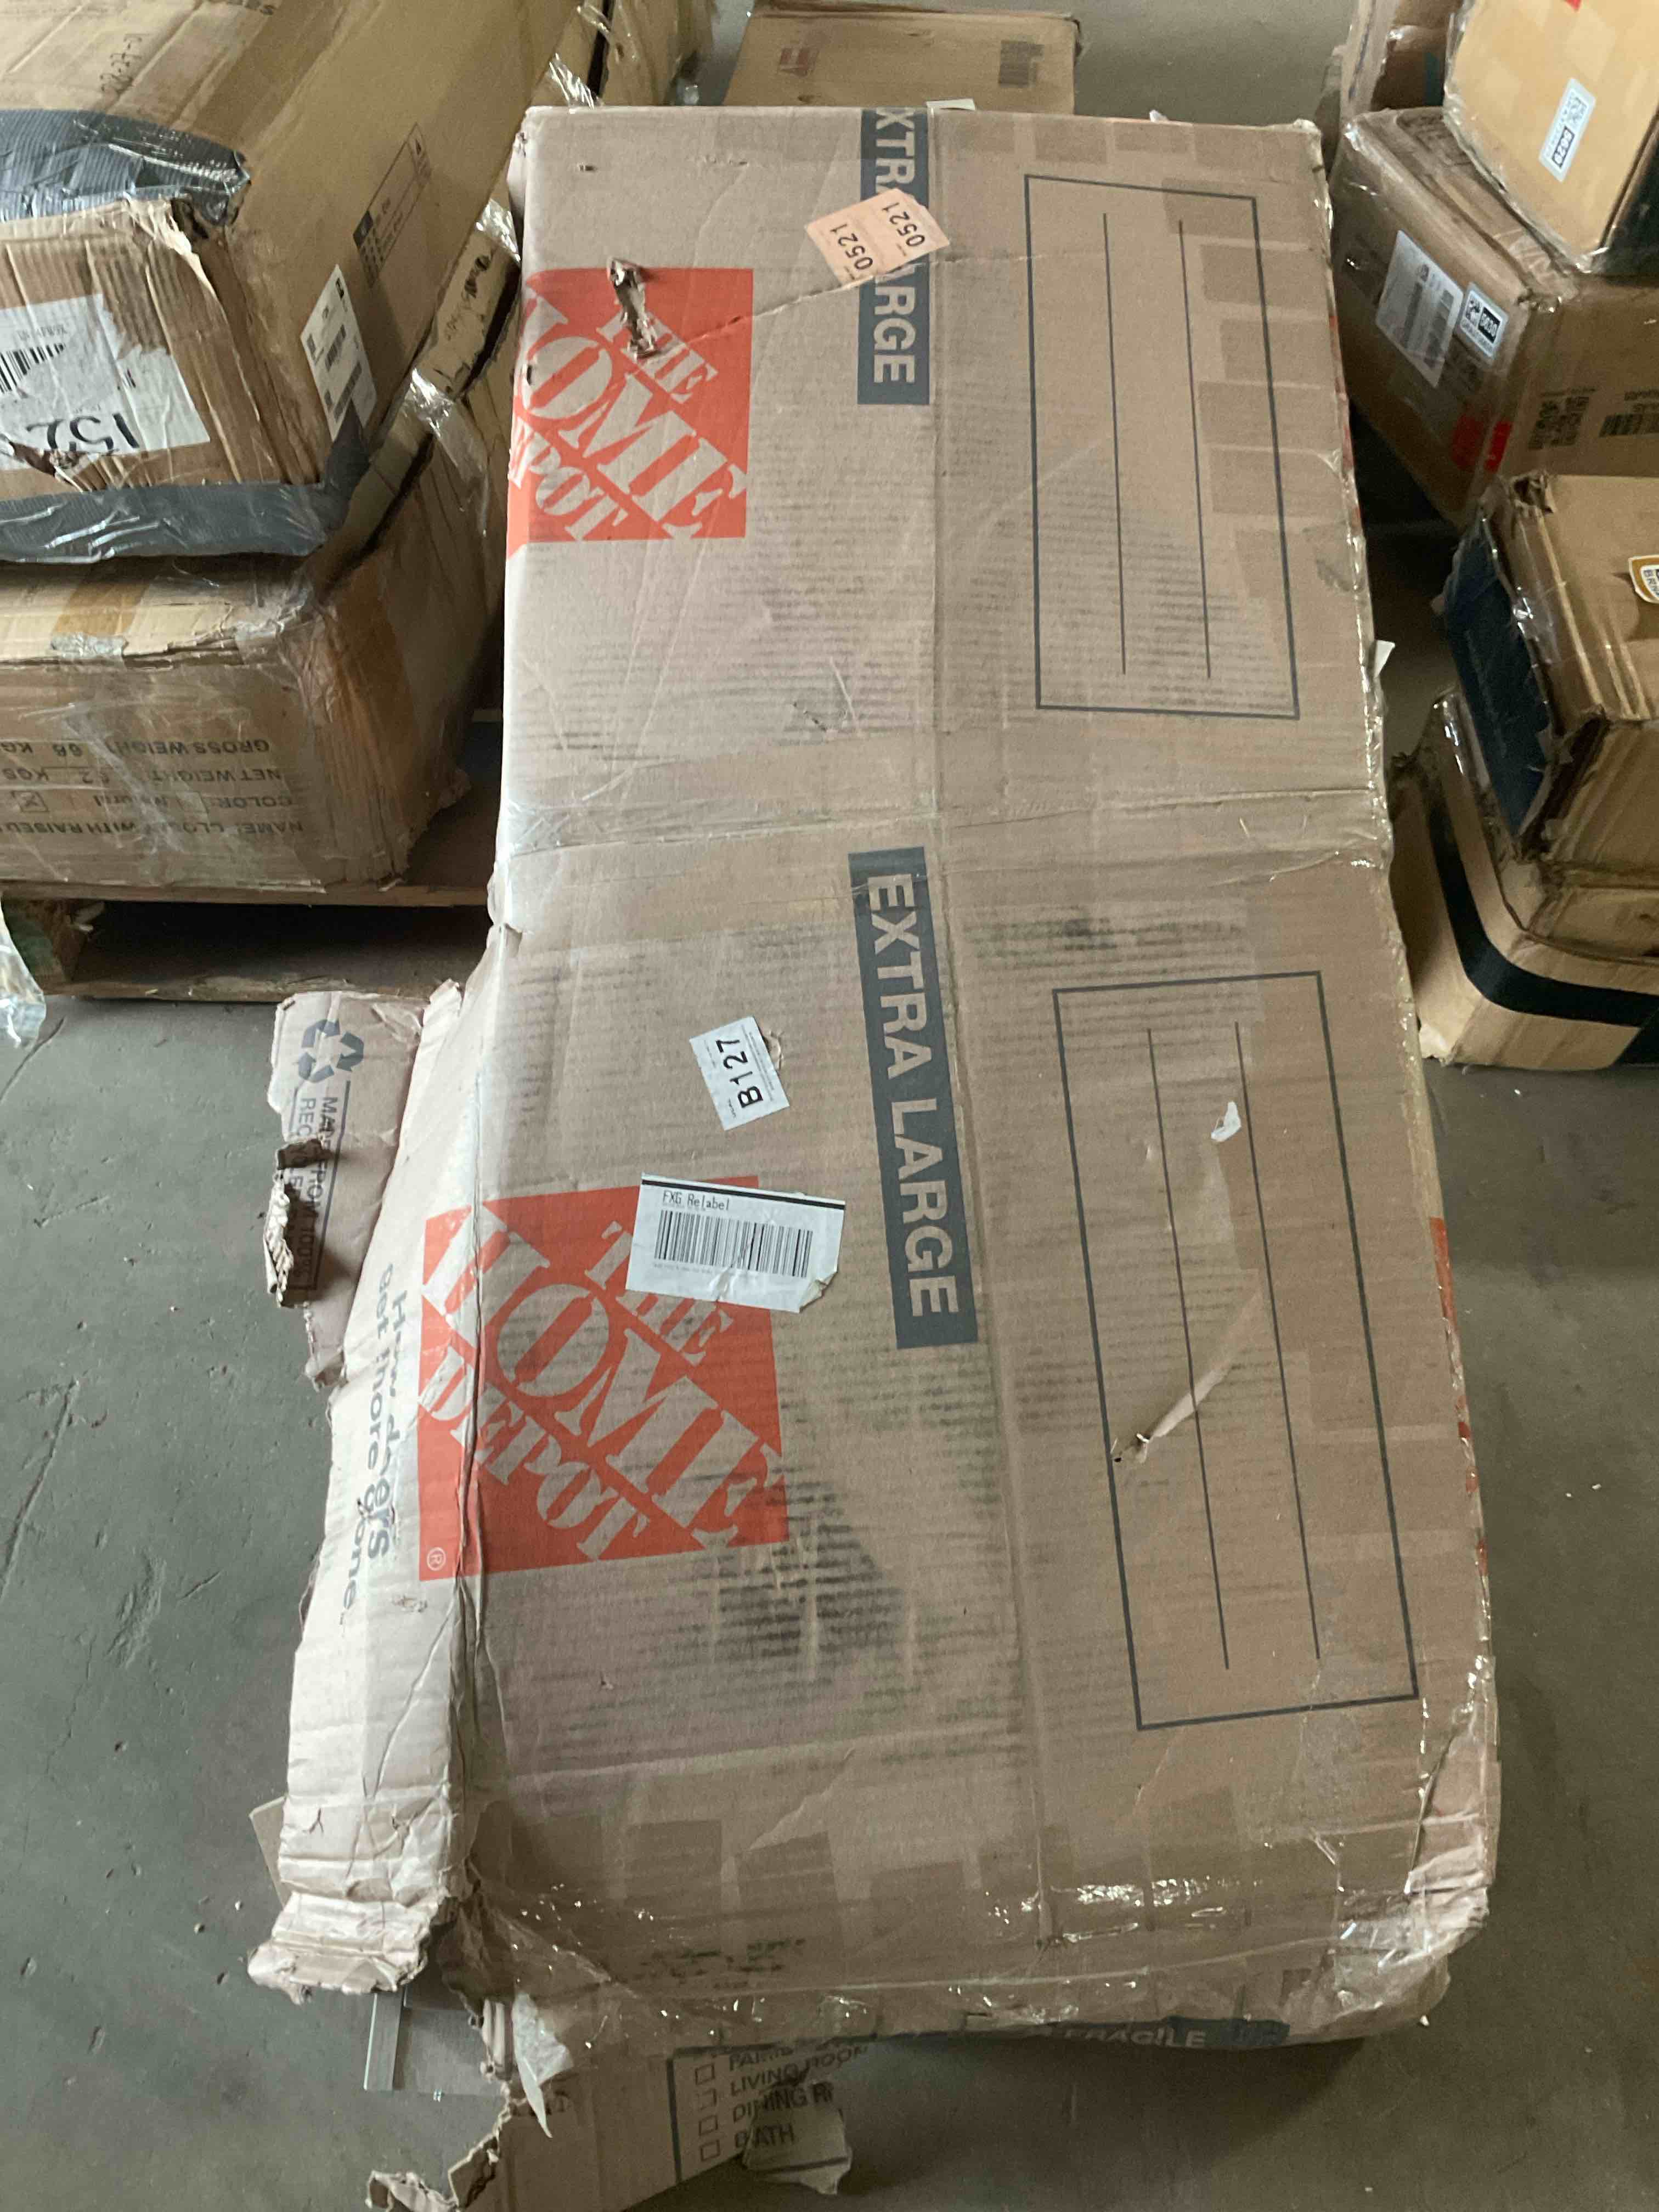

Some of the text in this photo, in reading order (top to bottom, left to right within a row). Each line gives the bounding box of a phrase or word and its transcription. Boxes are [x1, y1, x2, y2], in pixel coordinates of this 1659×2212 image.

[830, 224, 873, 270] 0521
[882, 202, 925, 247] 0521
[192, 739, 270, 754] GROSS
[241, 768, 282, 781] NET
[715, 1040, 764, 1108] B127
[867, 873, 959, 1317] EXTRA LARGE
[662, 1189, 730, 1211] FXG Relabel
[421, 1209, 785, 1550] HOME
[417, 1346, 650, 1560] DEPOT
